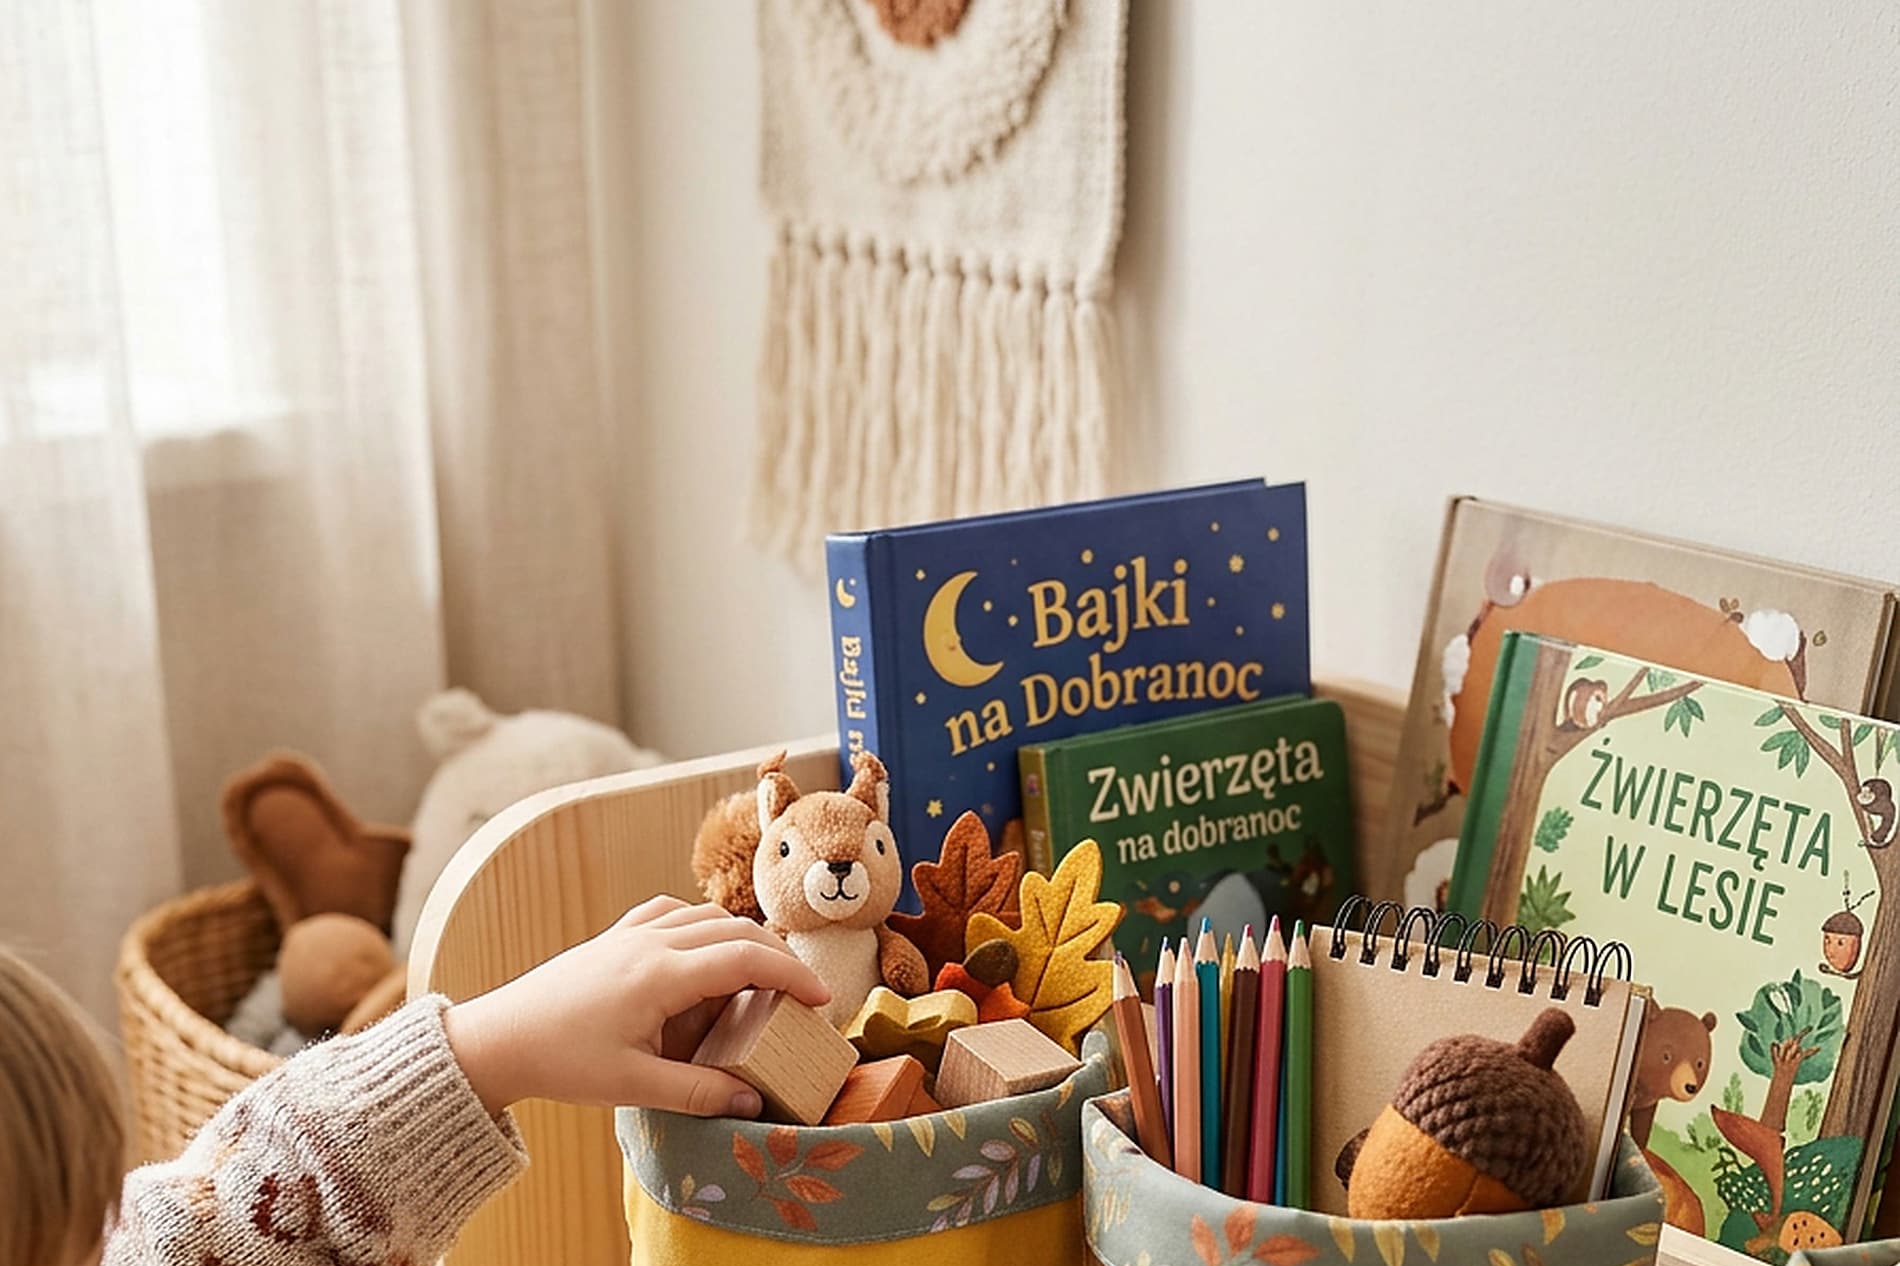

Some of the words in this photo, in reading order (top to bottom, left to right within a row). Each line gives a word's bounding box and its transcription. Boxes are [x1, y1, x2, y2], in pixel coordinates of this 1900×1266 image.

[1028, 556, 1191, 653] Bajki
[945, 698, 1013, 757] na
[1019, 652, 1265, 728] Dobranoc
[1086, 736, 1324, 823] Zwierzęta
[1579, 736, 1834, 878] ŻWIERZĘTA
[1116, 832, 1158, 865] na
[1162, 803, 1303, 856] dobranoc
[1601, 834, 1647, 900] W
[1657, 853, 1787, 946] LESIE
